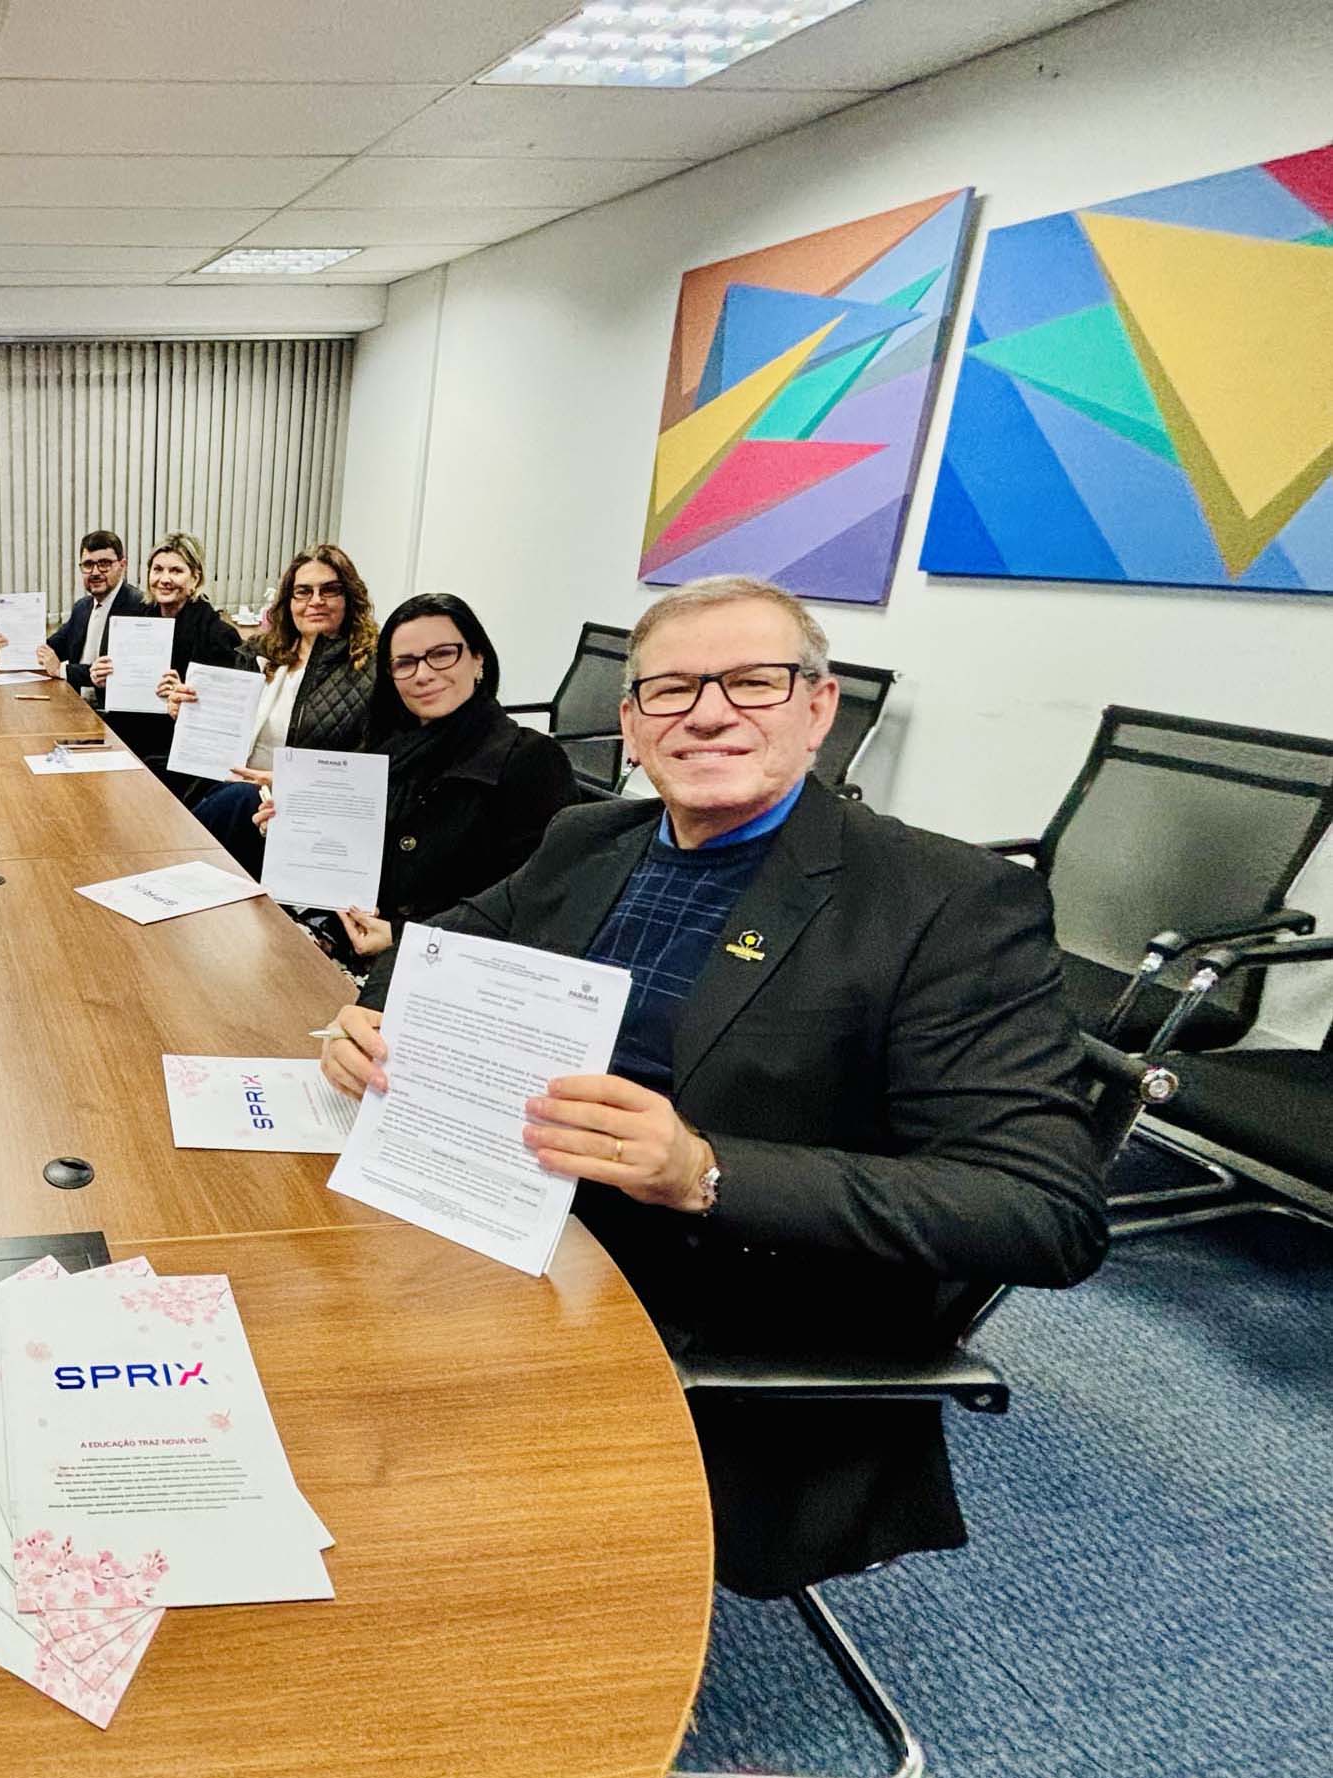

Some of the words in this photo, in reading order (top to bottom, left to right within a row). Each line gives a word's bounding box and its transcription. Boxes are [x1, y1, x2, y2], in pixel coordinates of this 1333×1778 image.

[241, 1073, 274, 1129] SPRIX
[54, 1362, 209, 1390] SPRIX
[88, 1438, 136, 1448] EDUCAÇÃO
[162, 1438, 186, 1446] NOVA
[187, 1437, 209, 1445] VIDA
